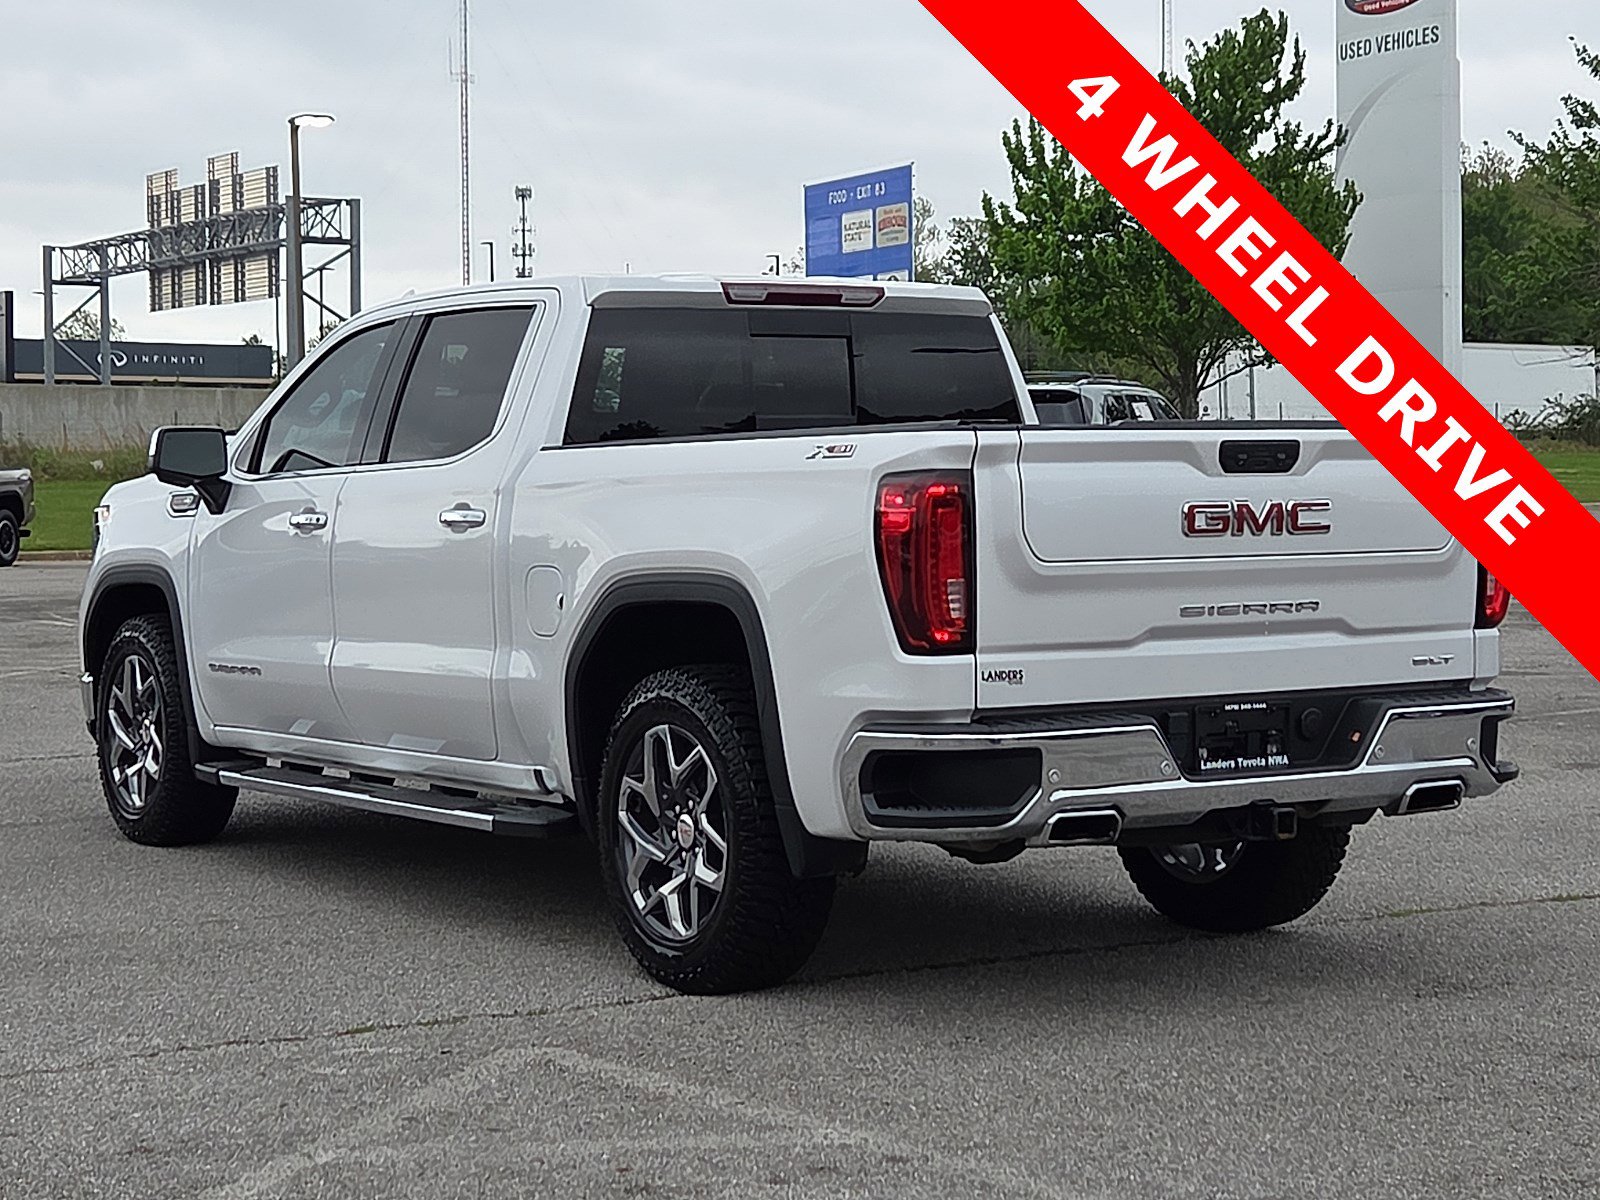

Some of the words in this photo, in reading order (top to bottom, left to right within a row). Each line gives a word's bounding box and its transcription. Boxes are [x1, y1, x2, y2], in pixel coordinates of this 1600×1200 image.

[1340, 38, 1372, 61] USED
[1375, 25, 1440, 54] VEHICLES
[828, 189, 847, 205] FOOD
[856, 184, 872, 200] EXIT
[133, 354, 205, 365] INFINITI
[1181, 498, 1332, 538] GMC
[1179, 600, 1320, 618] SIERRA
[981, 669, 1024, 682] LANDERS
[1200, 758, 1235, 770] Landers
[1237, 756, 1266, 769] Toyota
